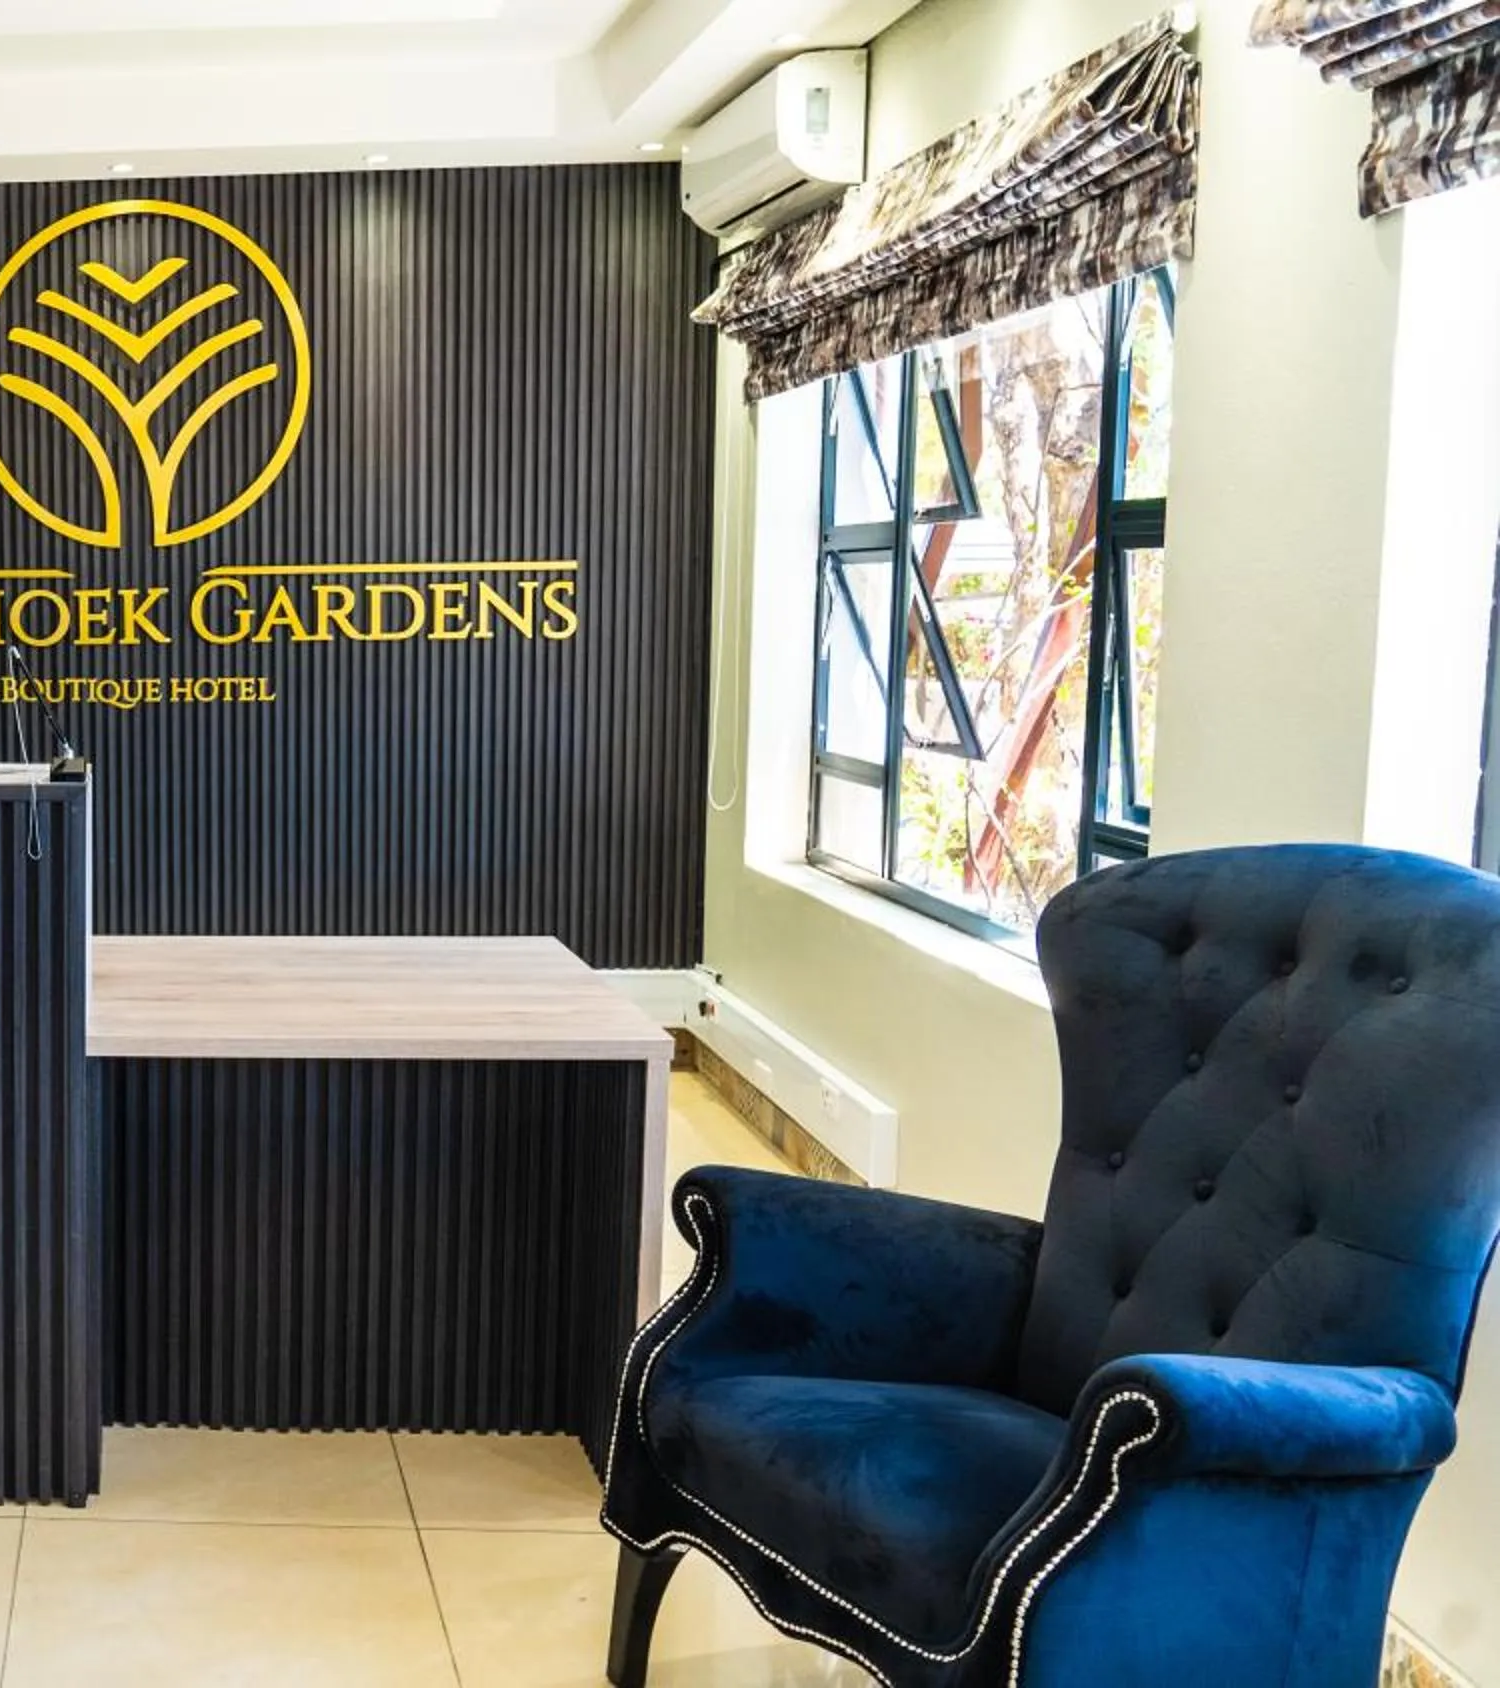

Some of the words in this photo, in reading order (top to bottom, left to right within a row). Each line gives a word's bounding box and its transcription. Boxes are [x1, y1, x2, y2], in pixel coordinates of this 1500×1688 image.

[190, 576, 579, 645] GARDENS
[1, 676, 161, 710] BOUTIQUE
[169, 677, 276, 703] HOTEL
